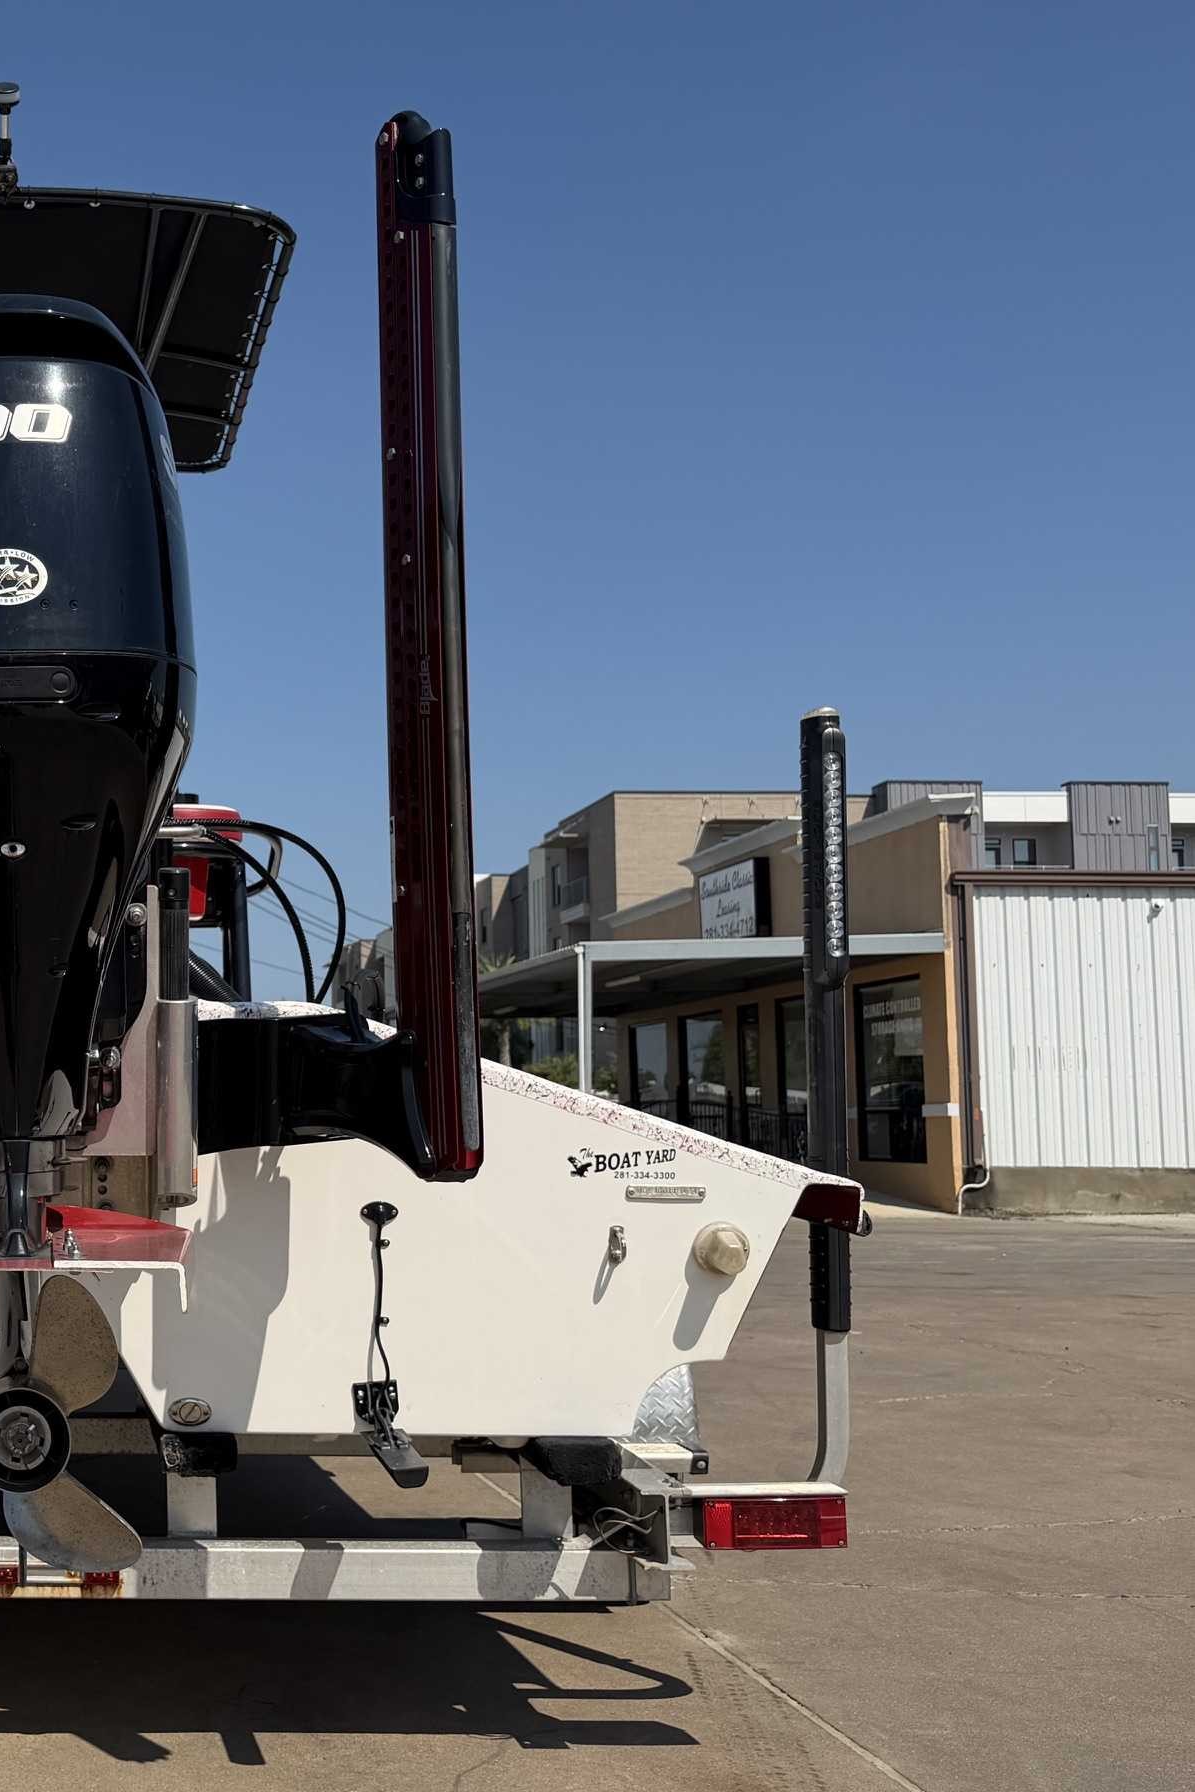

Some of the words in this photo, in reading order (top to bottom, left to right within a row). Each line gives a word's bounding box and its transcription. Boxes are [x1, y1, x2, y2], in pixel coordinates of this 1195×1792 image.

[15, 551, 35, 562] LOW
[594, 1151, 641, 1172] BOAT
[645, 1149, 676, 1165] YARD
[614, 1171, 676, 1180] 281-334-3300
